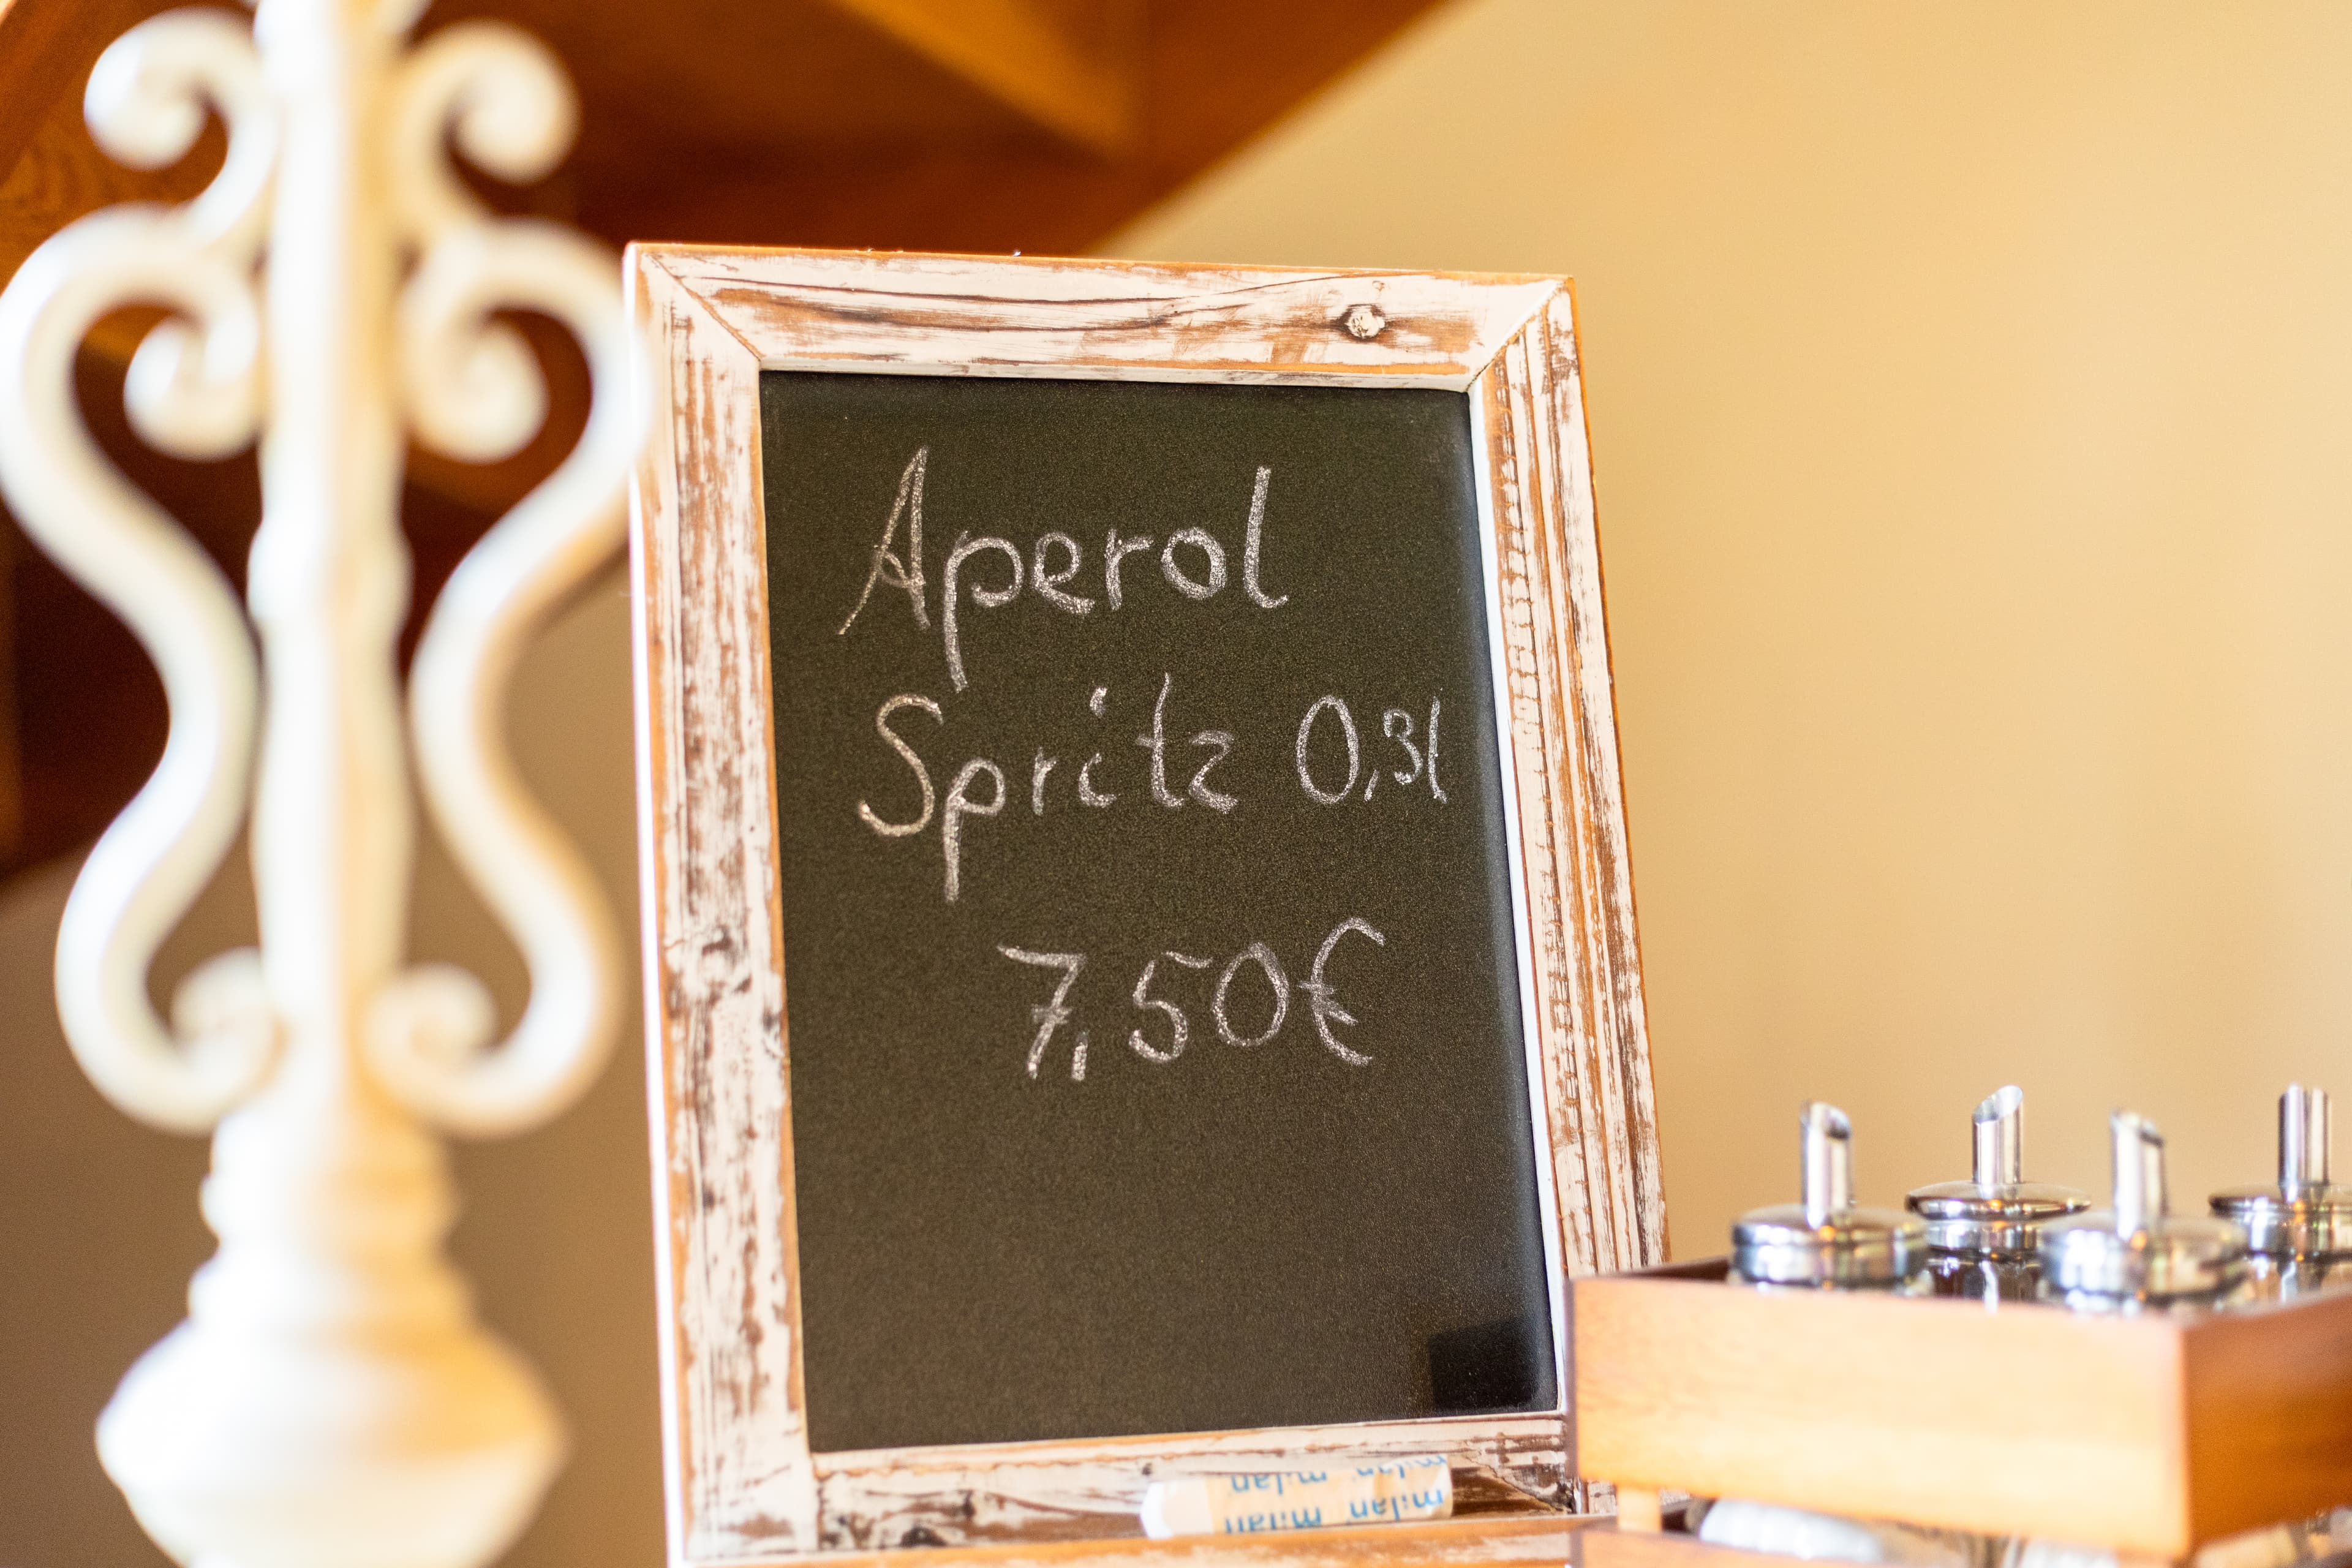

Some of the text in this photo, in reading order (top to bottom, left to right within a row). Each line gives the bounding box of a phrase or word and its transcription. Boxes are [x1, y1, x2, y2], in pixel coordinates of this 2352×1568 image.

[839, 445, 1288, 692] Aperol
[860, 672, 1238, 902] Spritz
[997, 917, 1385, 1082] 7,50€
[1349, 1489, 1444, 1523] milan
